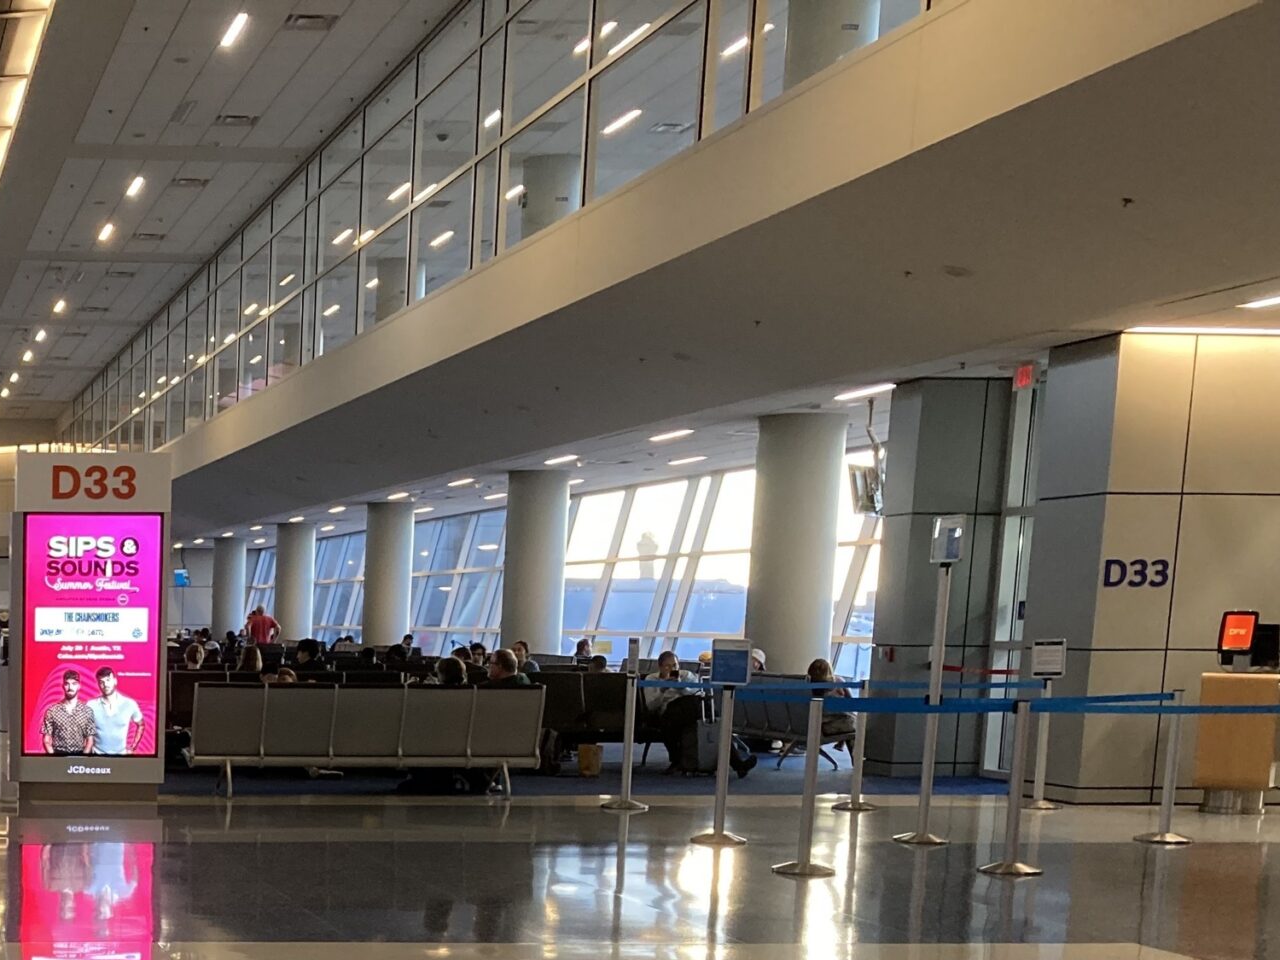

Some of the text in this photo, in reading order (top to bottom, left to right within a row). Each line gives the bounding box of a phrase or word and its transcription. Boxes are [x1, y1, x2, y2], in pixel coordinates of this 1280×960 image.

[52, 465, 137, 500] D33
[48, 536, 137, 559] SIPS &
[46, 560, 139, 577] SOUNDS
[1103, 559, 1169, 588] D33
[67, 766, 111, 775] JCDecaux
